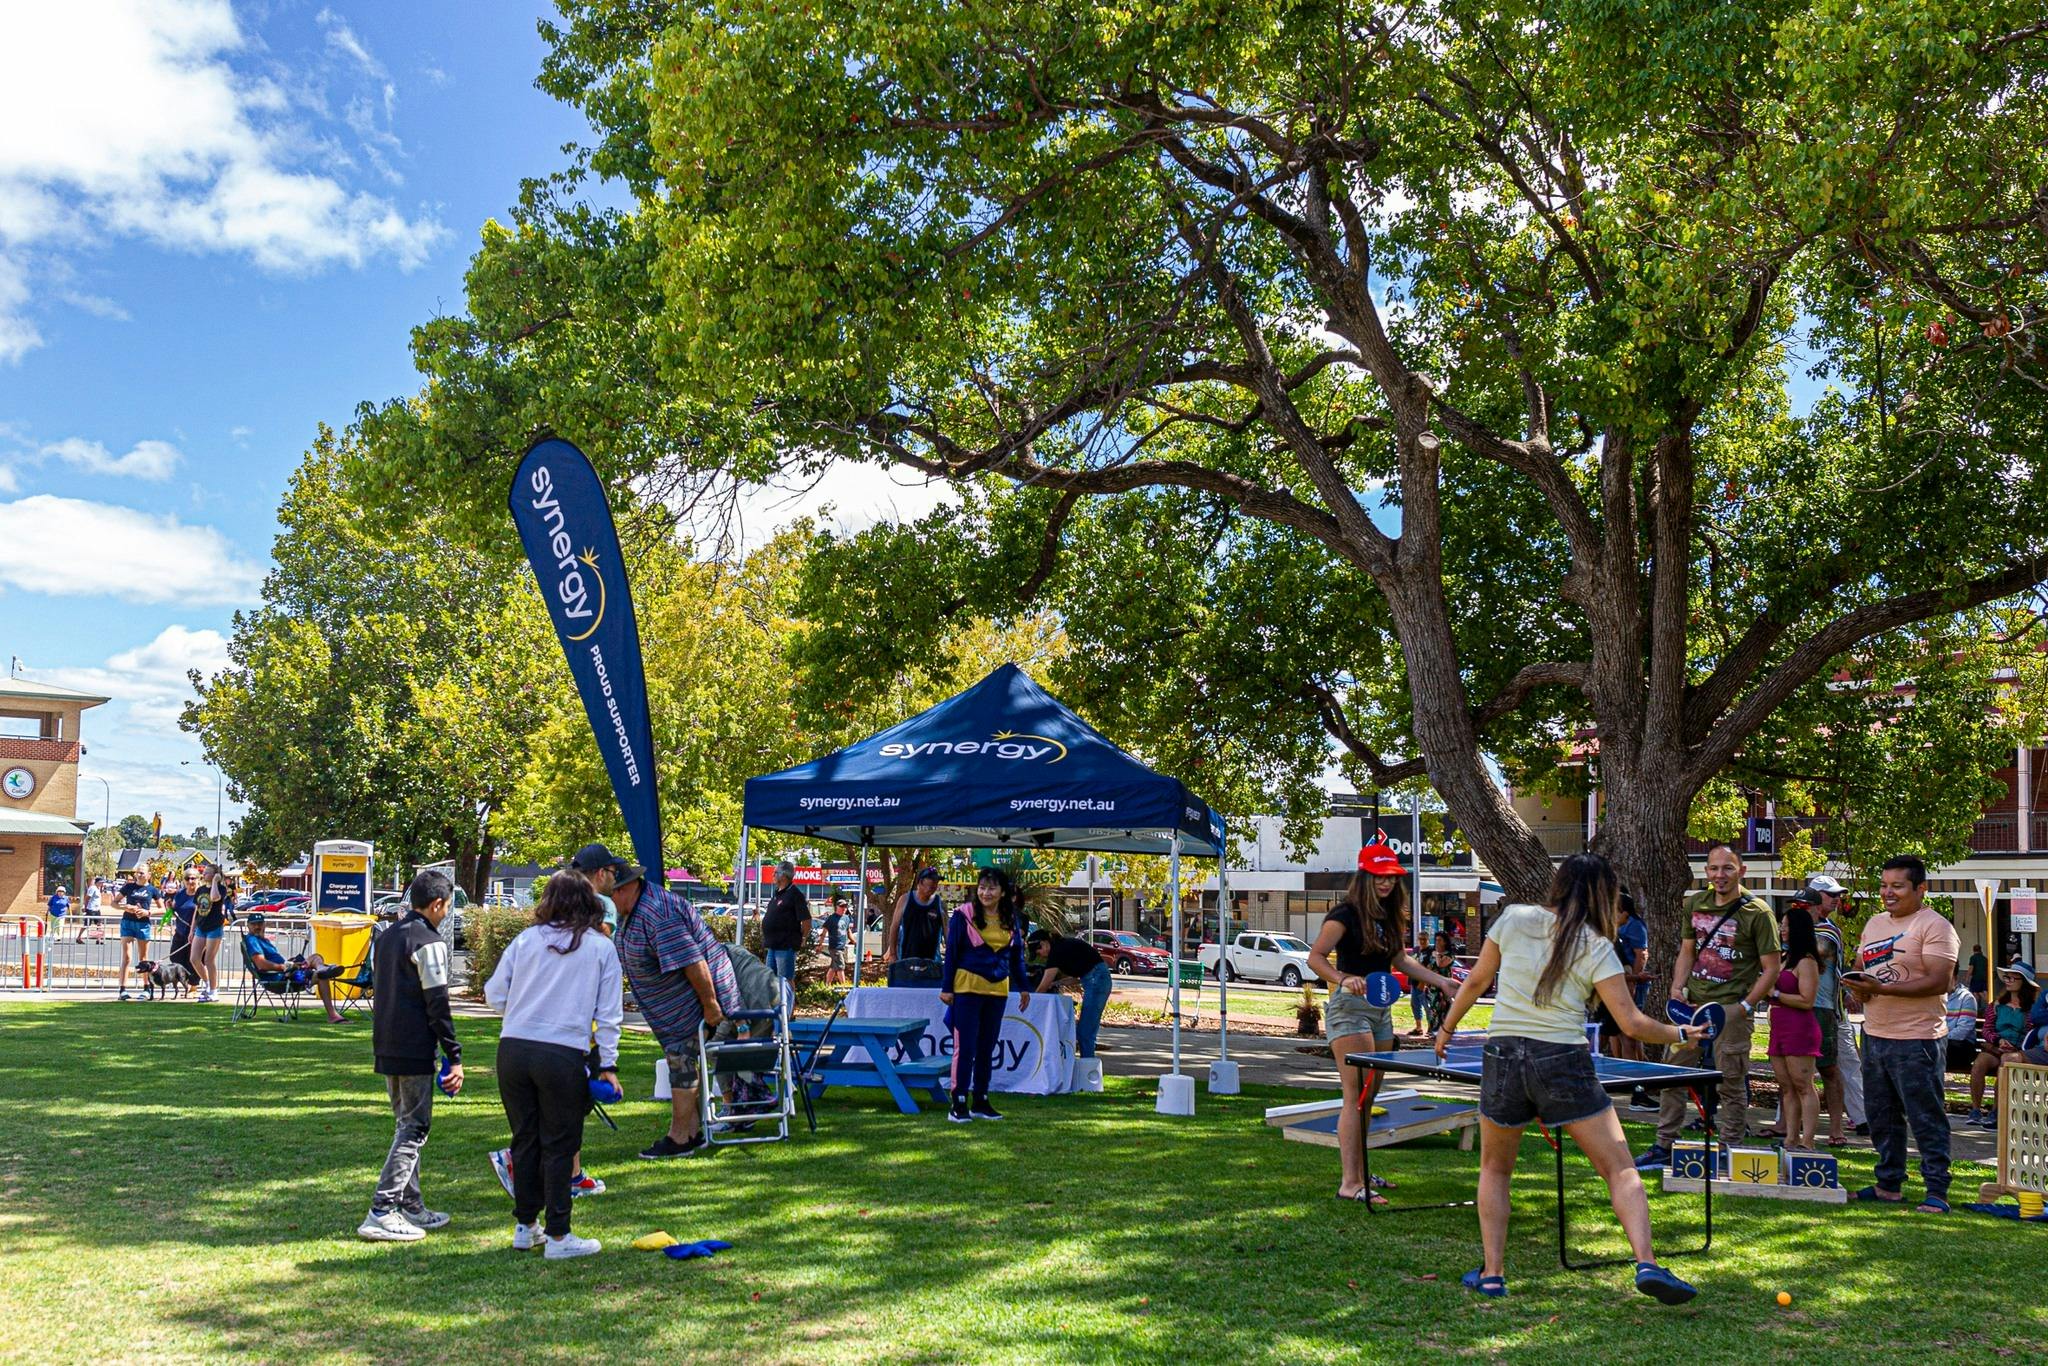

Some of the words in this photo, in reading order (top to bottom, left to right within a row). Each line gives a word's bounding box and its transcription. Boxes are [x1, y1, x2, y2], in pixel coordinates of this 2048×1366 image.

[531, 465, 593, 619] synergy
[590, 644, 612, 697] PROUD
[607, 697, 641, 787] SUPPORTER
[878, 741, 1052, 760] synergy
[799, 796, 901, 810] synergy.net.au
[1010, 798, 1115, 812] synergy.net.au
[1755, 827, 1772, 843] TAB
